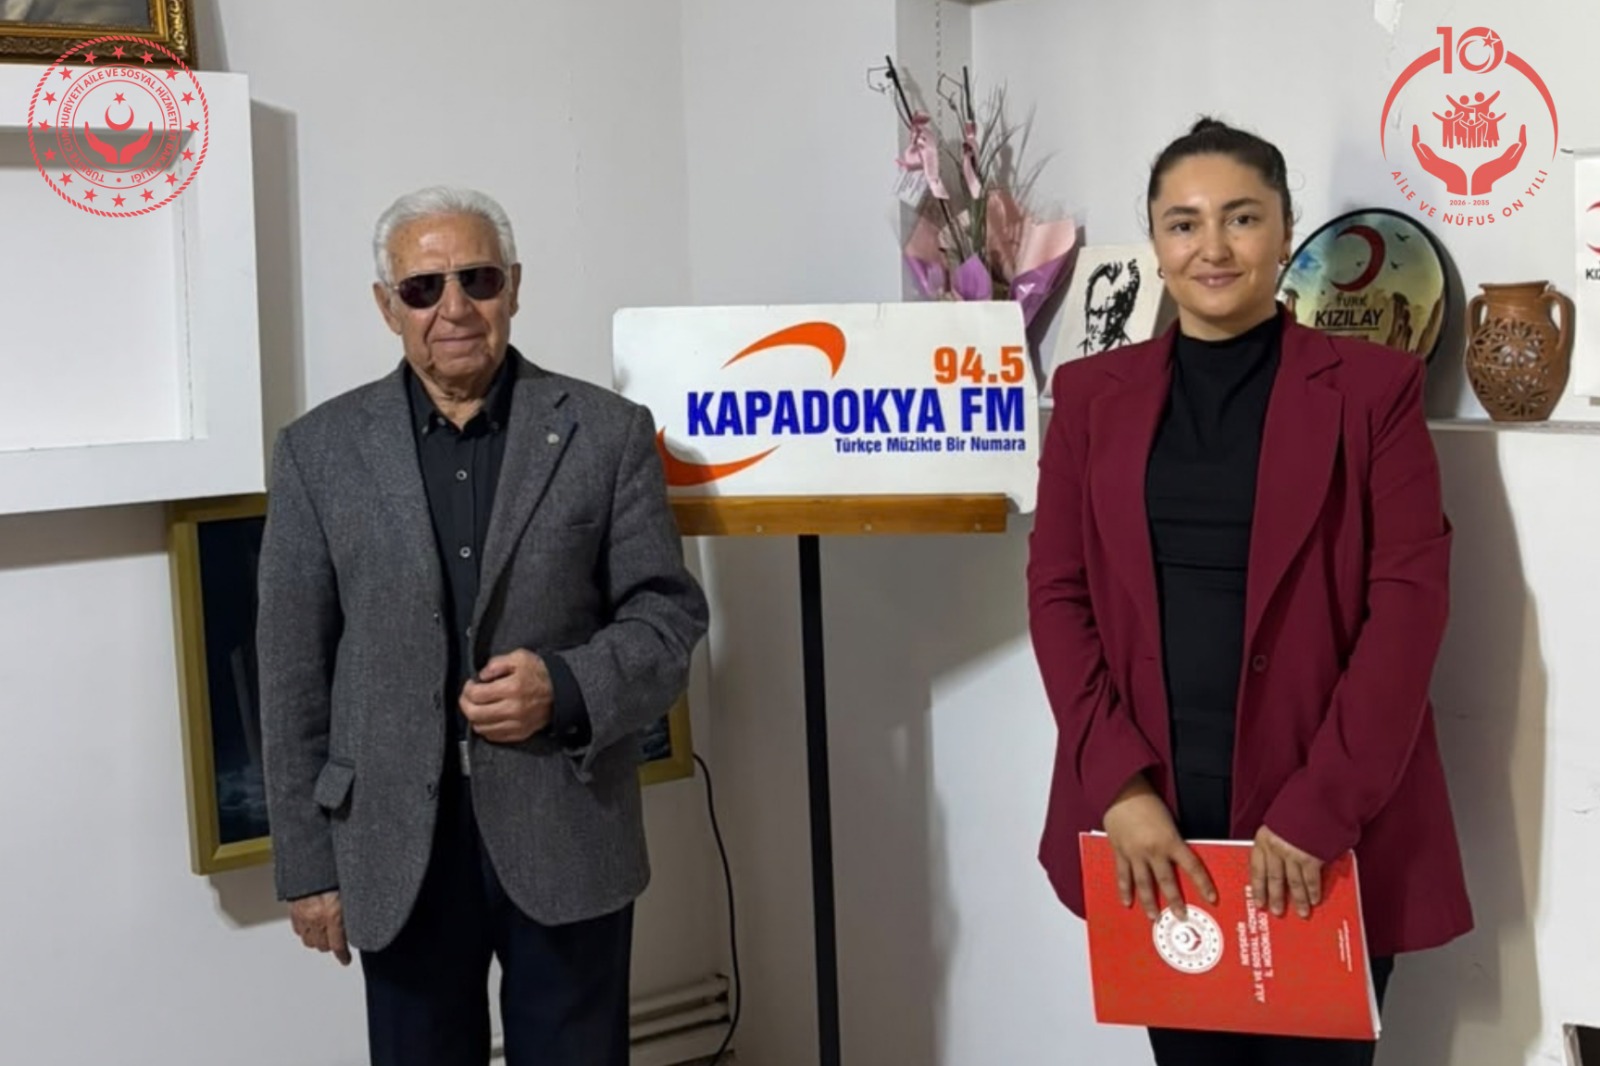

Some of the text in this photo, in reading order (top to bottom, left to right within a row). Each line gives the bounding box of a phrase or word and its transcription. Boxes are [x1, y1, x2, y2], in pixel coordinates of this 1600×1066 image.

[1315, 309, 1384, 327] KIZILAY
[934, 346, 1024, 384] 94.5
[687, 386, 1025, 436] KAPADOKYA FM
[835, 437, 1026, 454] Türkçe Müzikte Bir Numara
